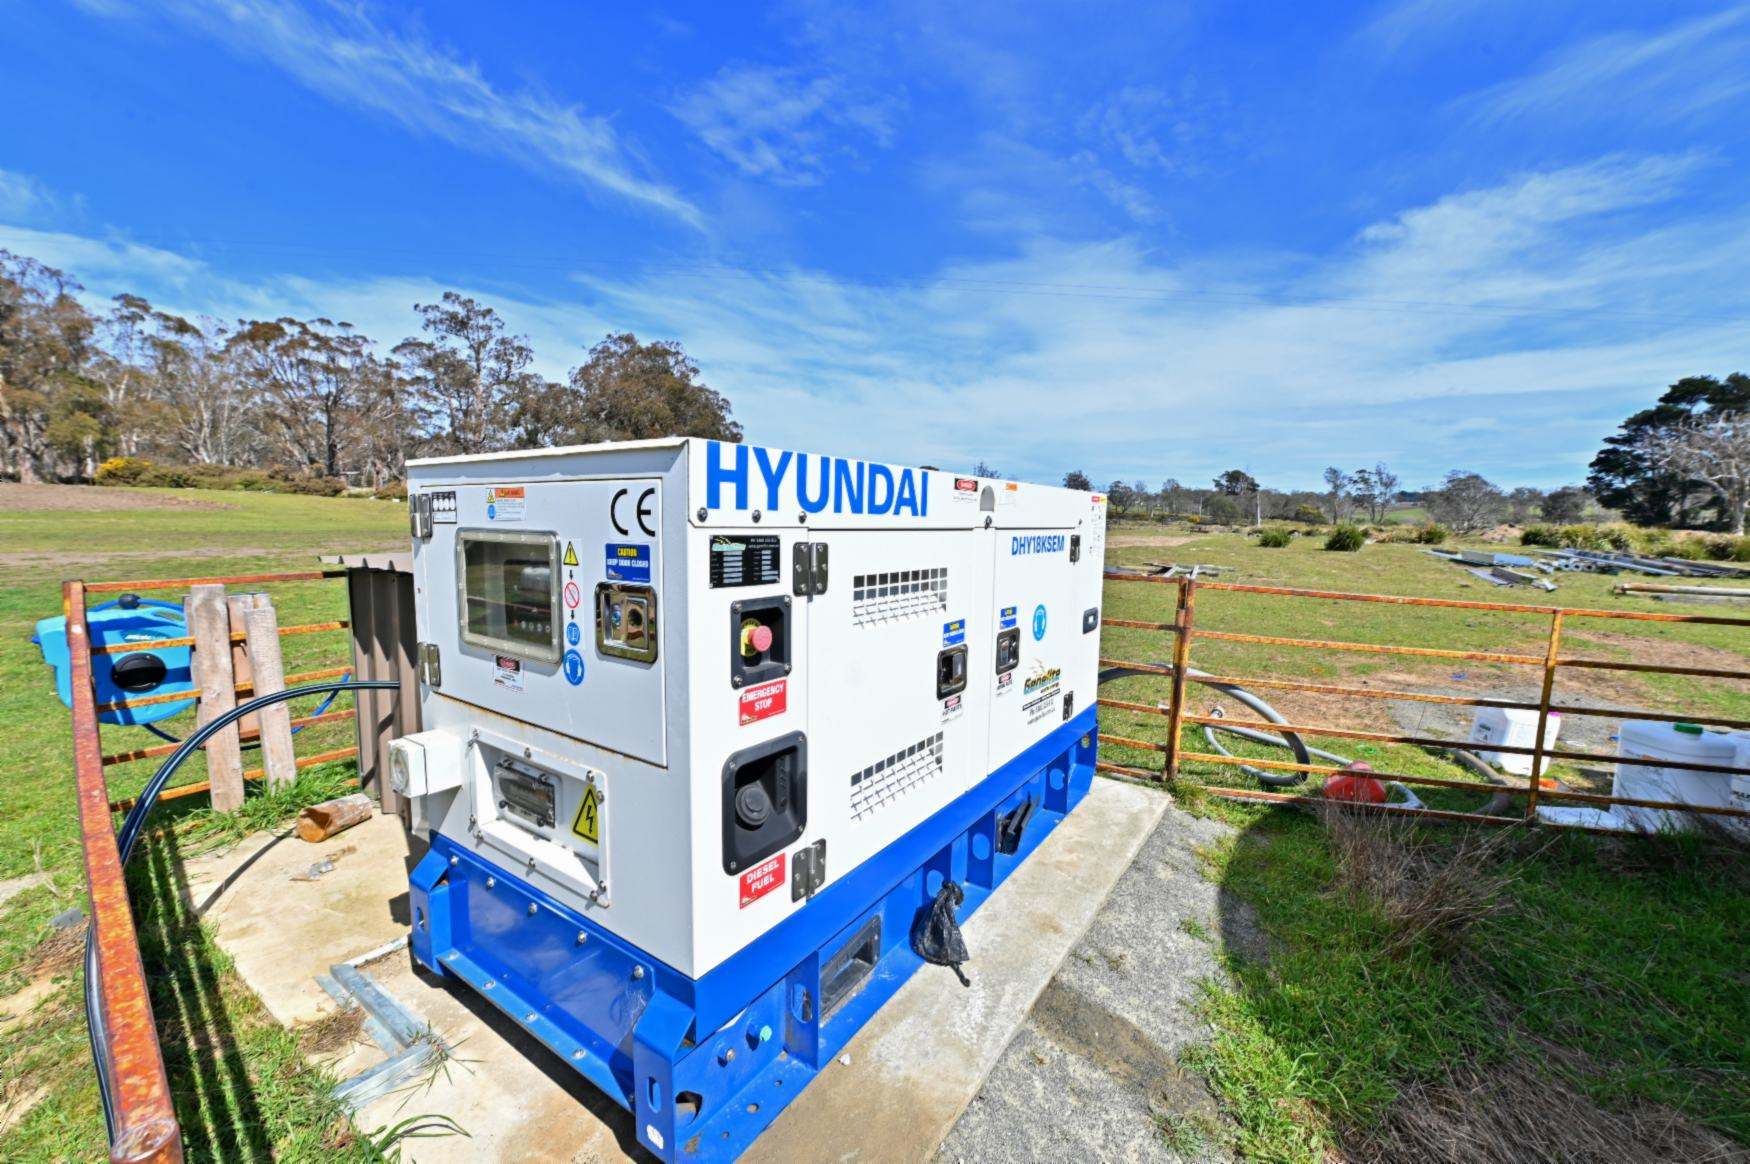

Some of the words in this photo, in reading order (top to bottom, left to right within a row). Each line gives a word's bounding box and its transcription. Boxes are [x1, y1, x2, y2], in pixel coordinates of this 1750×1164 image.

[706, 441, 929, 516] HYUNDAI
[610, 487, 656, 537] CE
[1011, 535, 1065, 556] DHY18KSEM
[742, 682, 785, 703] EMERGENCY
[754, 697, 773, 712] STOP
[746, 858, 780, 884] DIESEL
[751, 872, 775, 893] FUEL
